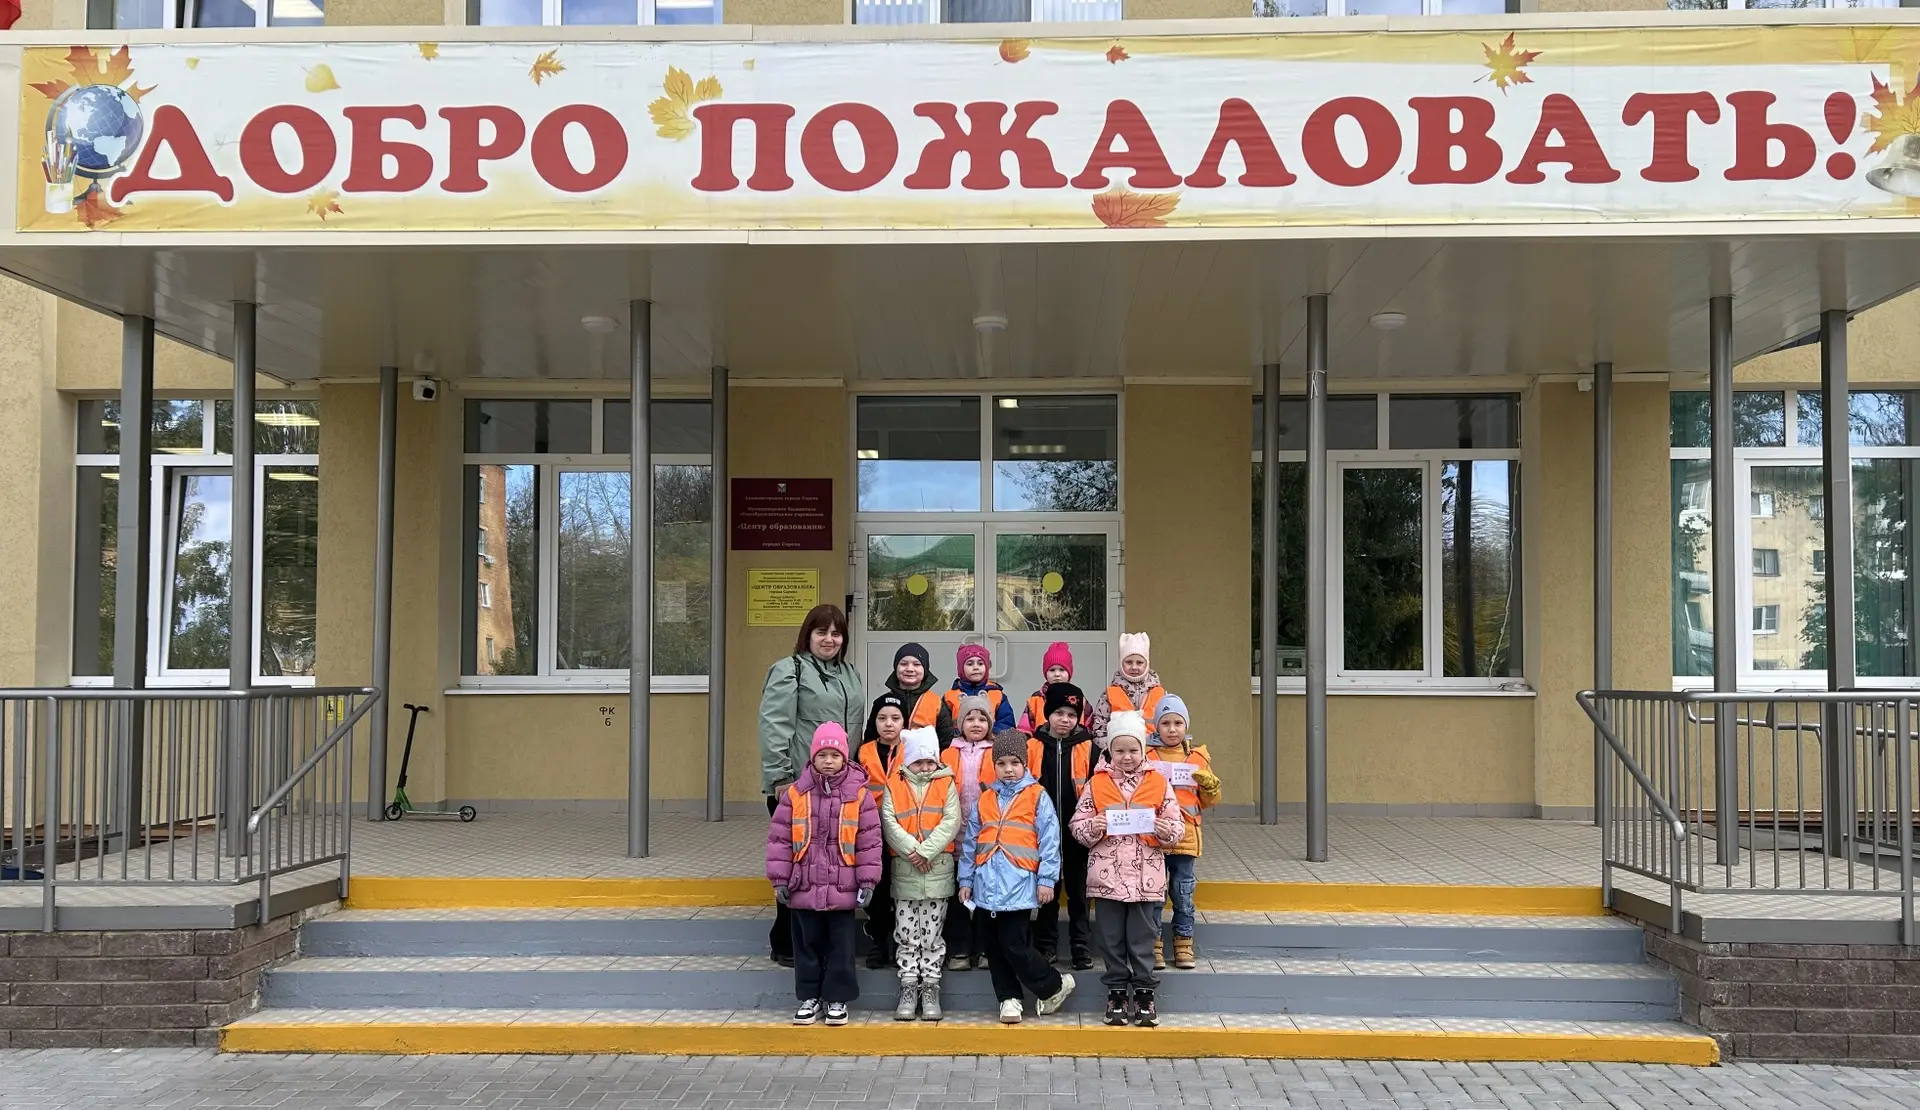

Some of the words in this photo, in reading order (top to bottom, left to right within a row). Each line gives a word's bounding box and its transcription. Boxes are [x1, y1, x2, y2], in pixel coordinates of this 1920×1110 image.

[112, 105, 628, 202] ДОБРО
[692, 92, 1856, 191] ПОЖАЛОВАТЬ!
[604, 717, 612, 727] 6
